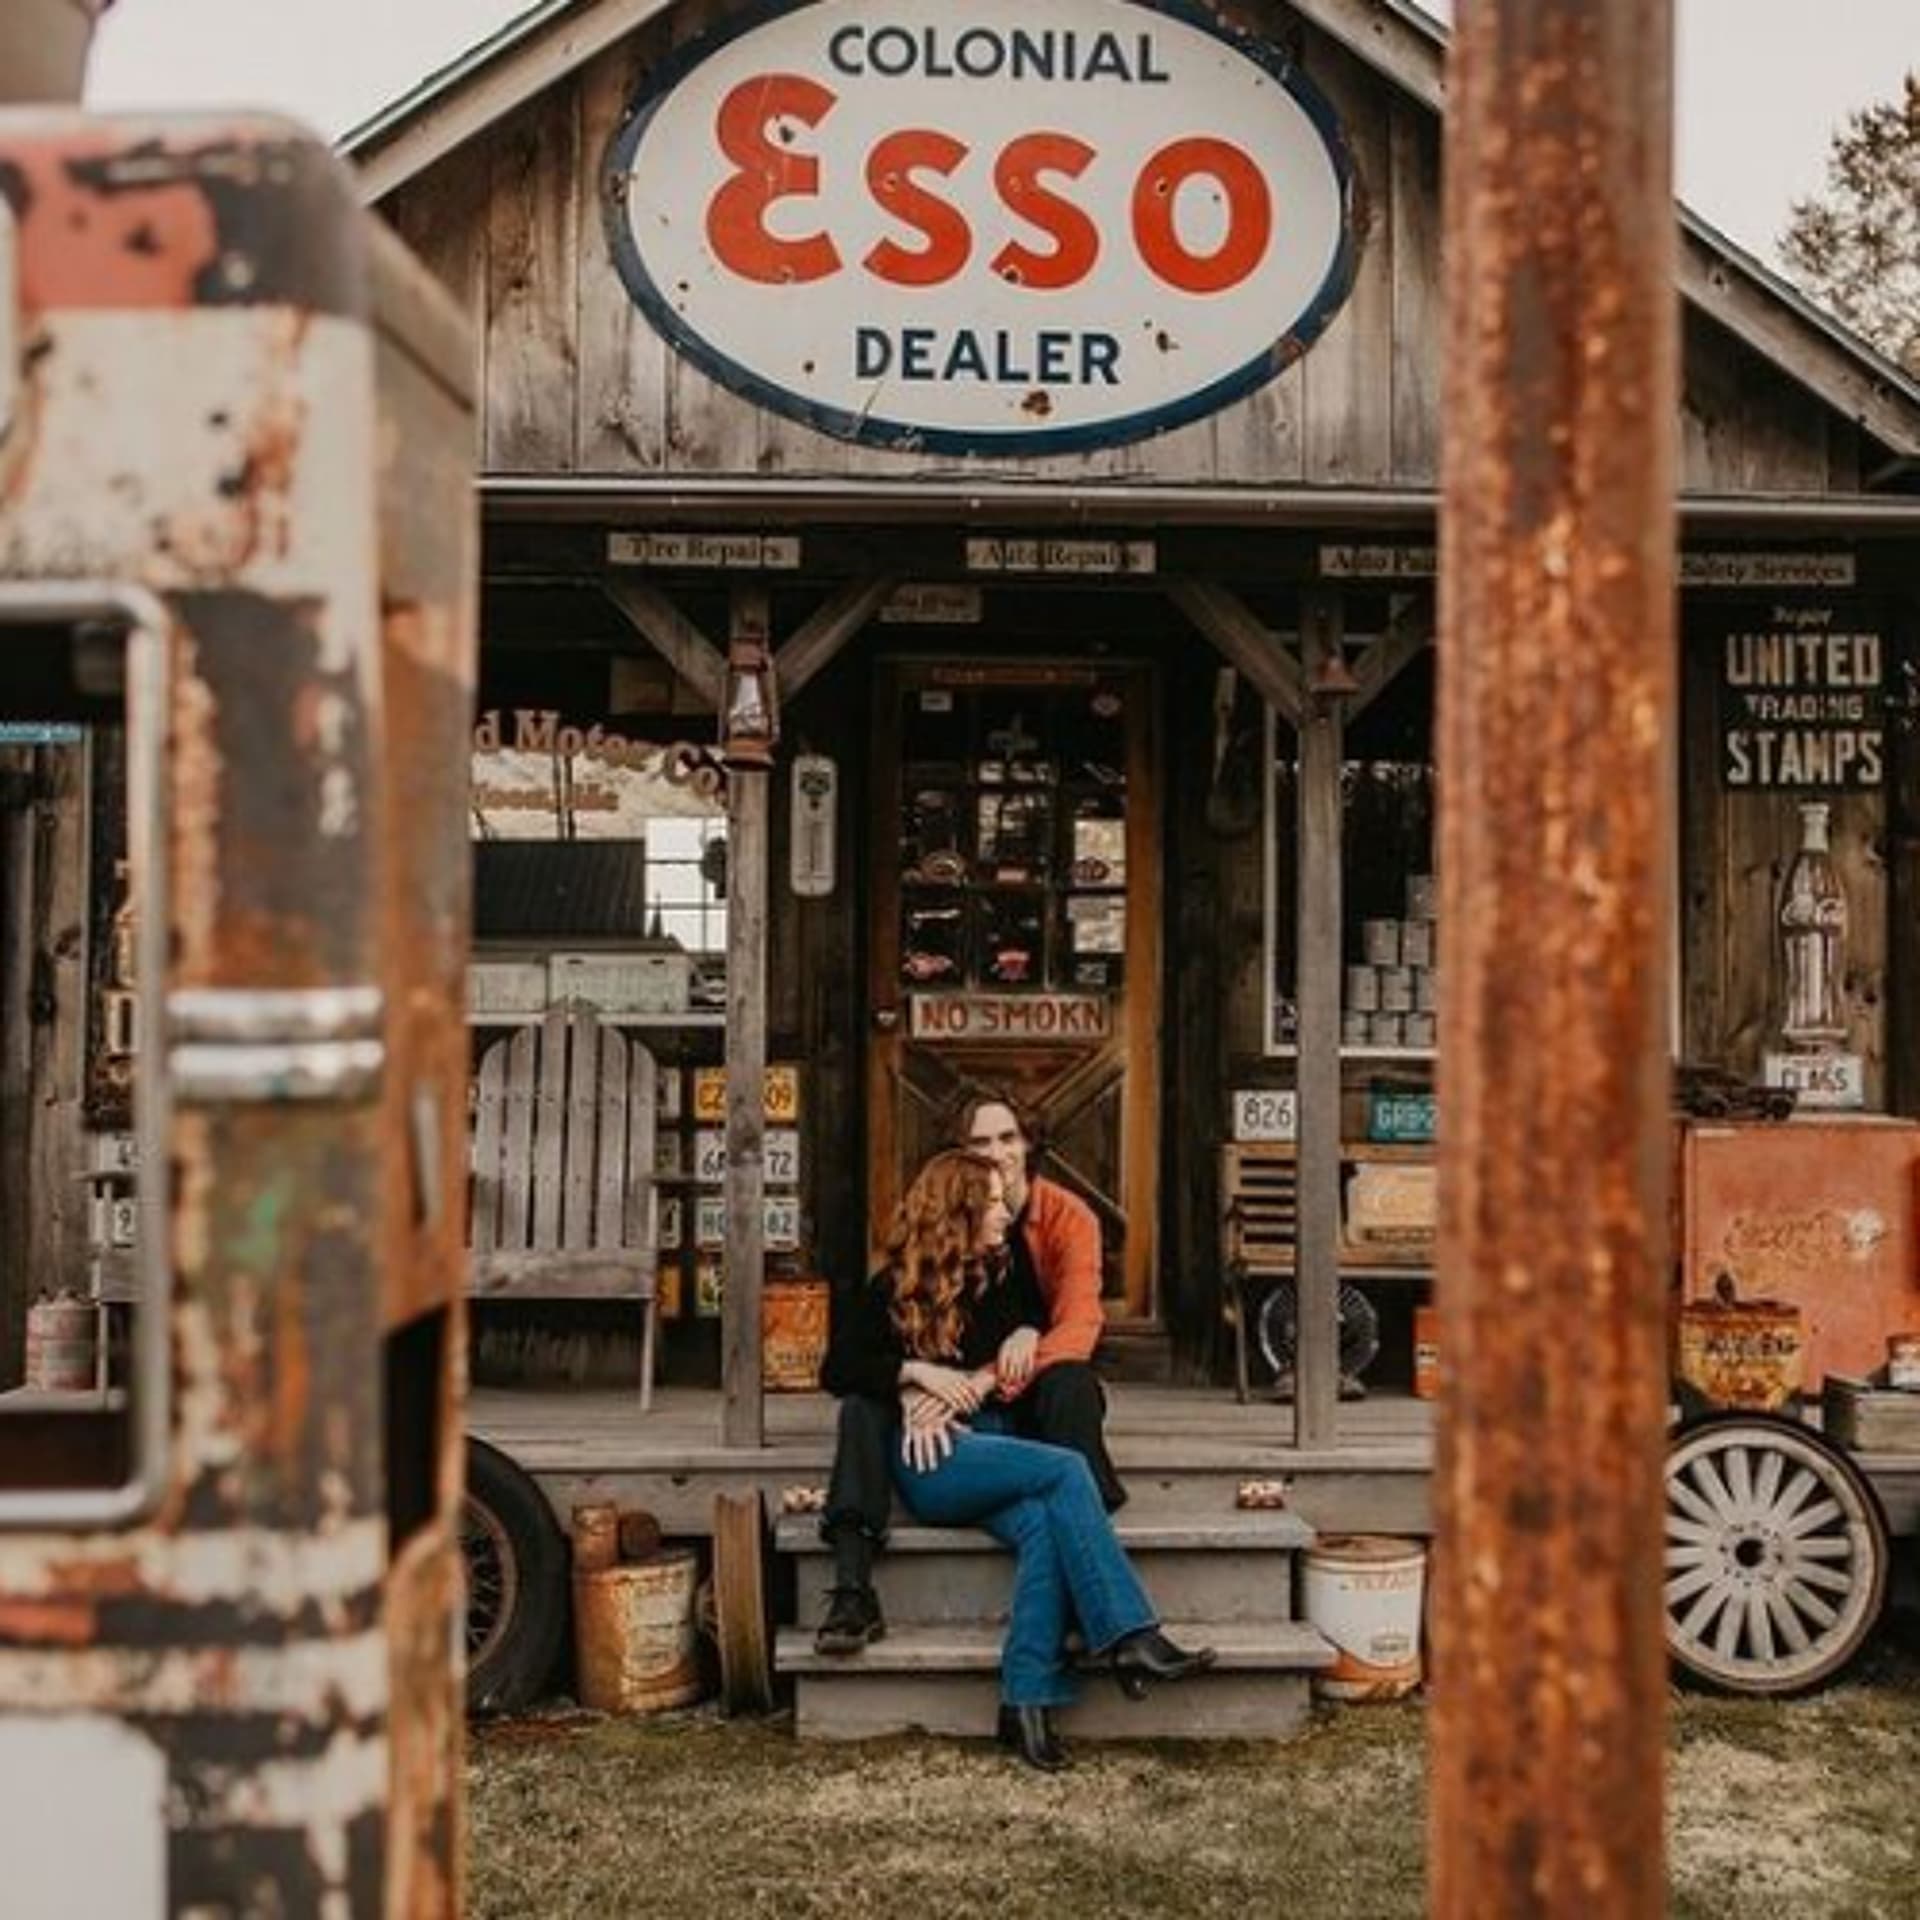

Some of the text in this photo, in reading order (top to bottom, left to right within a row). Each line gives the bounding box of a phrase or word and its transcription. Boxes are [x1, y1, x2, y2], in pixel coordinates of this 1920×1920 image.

[828, 25, 1169, 84] COLONIAL
[855, 328, 1121, 385] DEALER
[628, 536, 784, 566] Tire Repairs
[1752, 558, 1846, 581] Services
[1727, 634, 1880, 686] UNITED
[1743, 694, 1864, 719] TRADING
[514, 708, 660, 772] Motor
[1726, 730, 1883, 785] STAMPS
[921, 1000, 968, 1031] NO
[1243, 1098, 1291, 1129] 826
